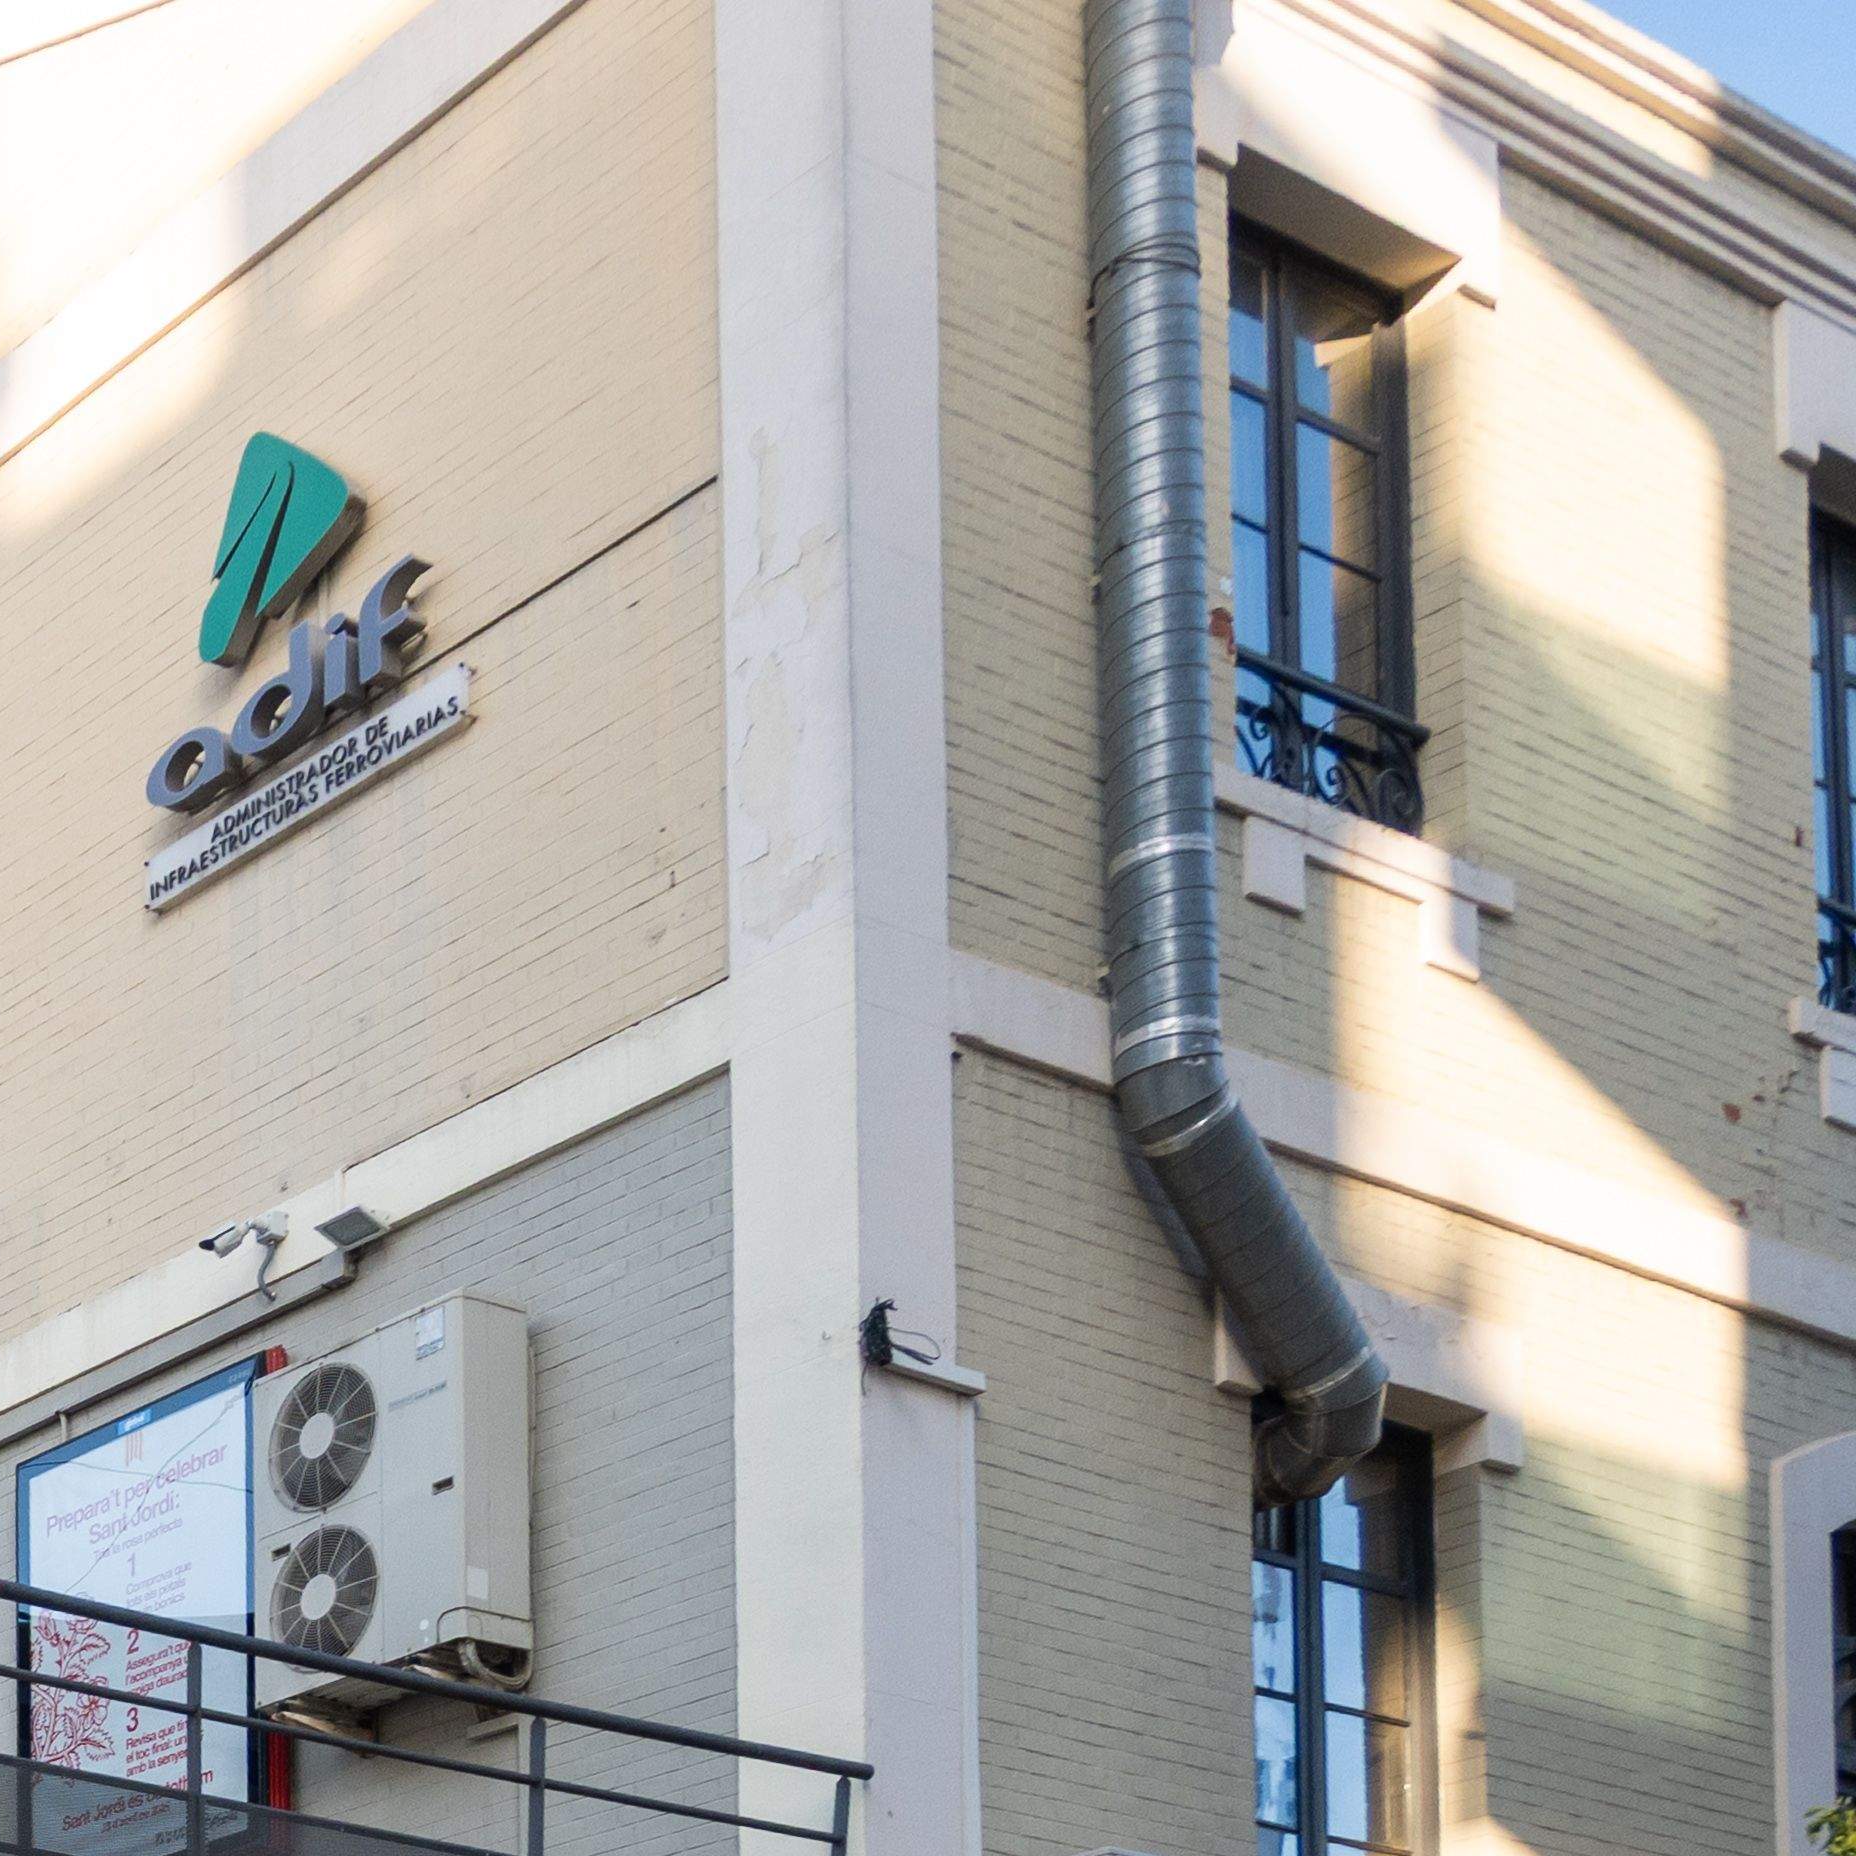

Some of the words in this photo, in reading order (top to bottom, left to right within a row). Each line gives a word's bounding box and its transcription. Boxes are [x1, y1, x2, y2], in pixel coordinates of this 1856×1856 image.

[146, 553, 433, 808] adif
[149, 785, 320, 901] INFRAESTRUCTURAS
[324, 696, 459, 793] FERROVIARIAS
[211, 737, 360, 844] ADMINISTRADOR
[365, 715, 388, 746] DE
[46, 1489, 121, 1538] Prepara't
[124, 1479, 151, 1509] per
[156, 1444, 228, 1490] celebrar
[89, 1514, 128, 1545] Sant
[131, 1490, 182, 1527] Jordi:
[127, 1552, 136, 1577] 1
[127, 1628, 140, 1655] 2
[126, 1707, 139, 1733] 3
[126, 1732, 157, 1750] Revisa
[158, 1725, 176, 1740] que
[126, 1764, 147, 1777] amb
